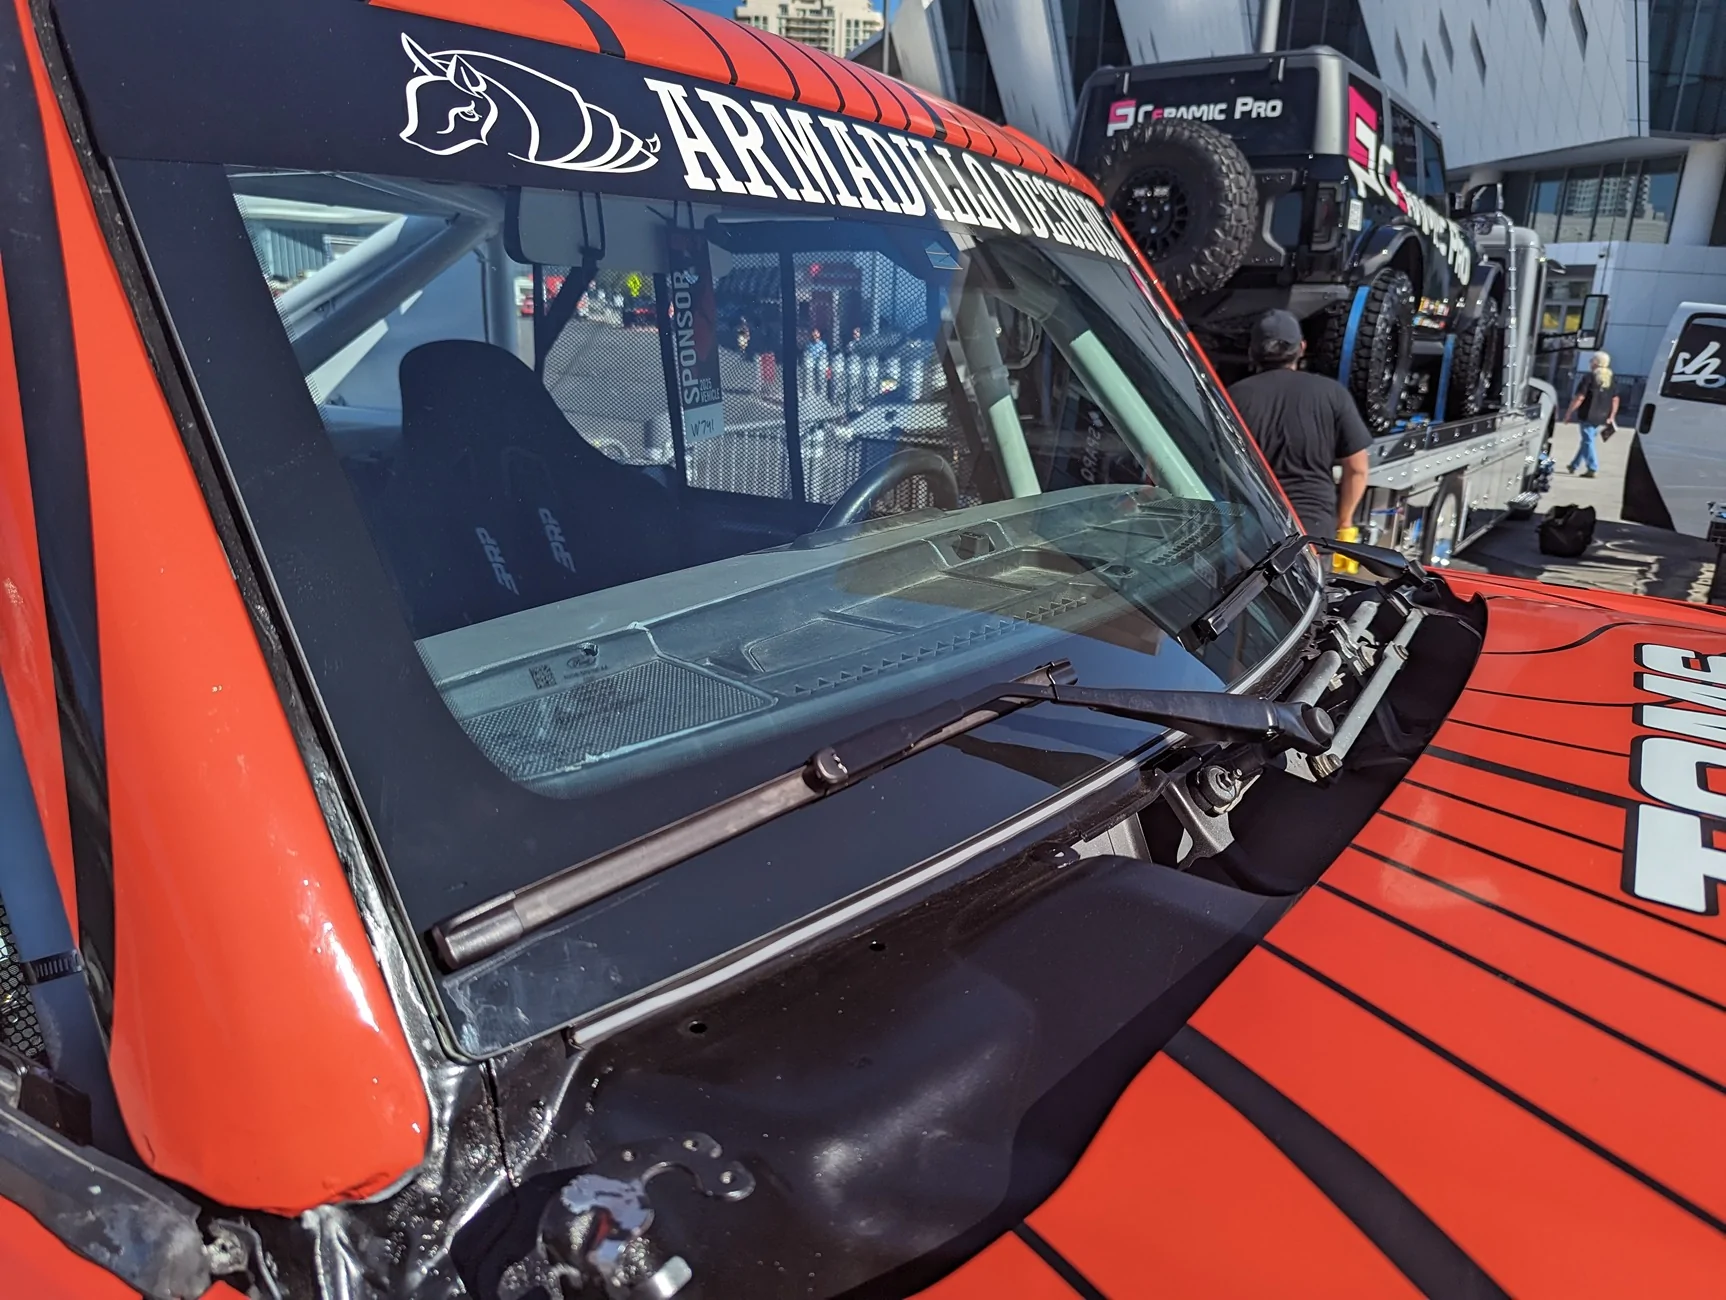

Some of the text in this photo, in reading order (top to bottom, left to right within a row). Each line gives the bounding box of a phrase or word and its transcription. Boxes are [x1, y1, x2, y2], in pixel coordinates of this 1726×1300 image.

[643, 77, 1131, 266] ARMADILLO DESIGNS
[673, 270, 700, 405] SPONSOR
